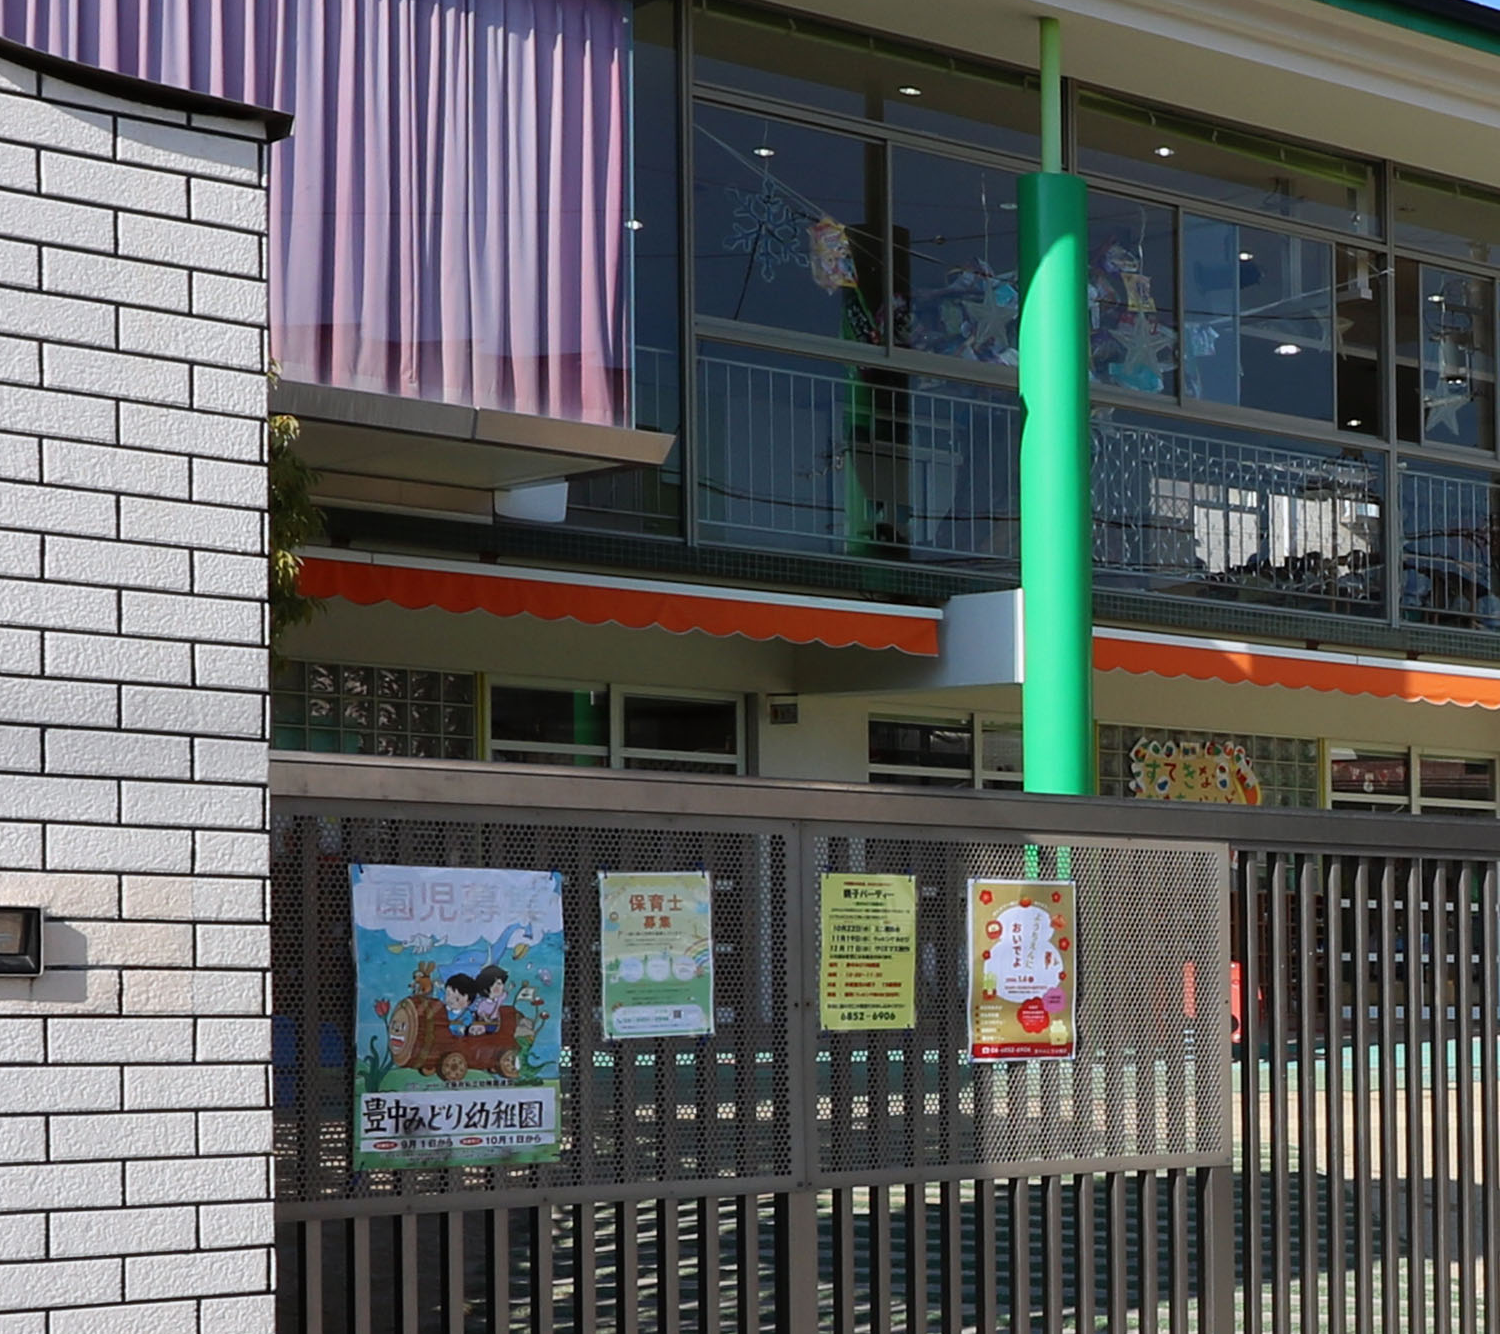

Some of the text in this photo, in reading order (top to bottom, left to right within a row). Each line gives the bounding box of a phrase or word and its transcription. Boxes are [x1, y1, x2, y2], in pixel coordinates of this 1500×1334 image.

[1145, 760, 1212, 789] すてきな
[375, 881, 545, 924] 園児募集
[629, 893, 683, 912] 保育士
[643, 915, 671, 929] 募集
[1012, 923, 1022, 968] おいでよ
[362, 1095, 543, 1134] 豊中みどり幼稚園
[485, 1134, 542, 1145] 10月1日から
